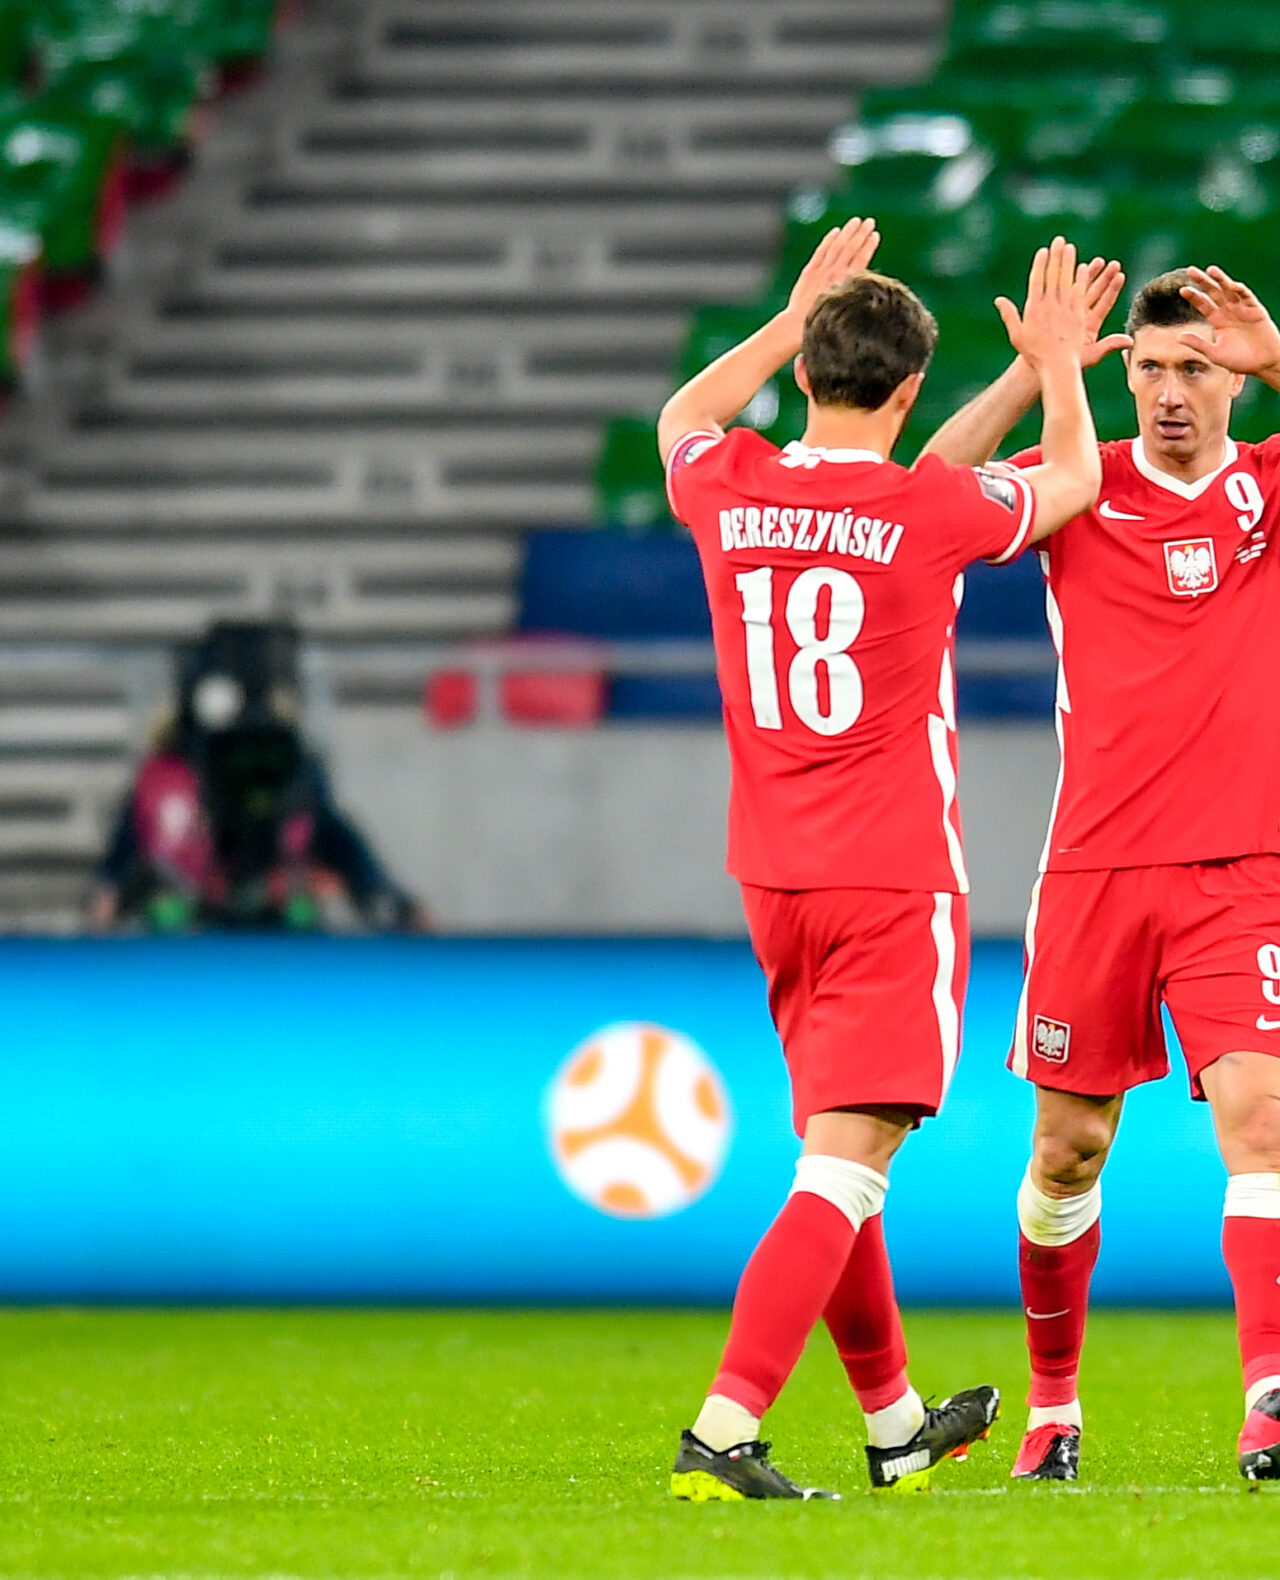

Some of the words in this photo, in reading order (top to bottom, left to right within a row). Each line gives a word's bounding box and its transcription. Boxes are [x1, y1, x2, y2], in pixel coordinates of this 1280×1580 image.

[1224, 472, 1264, 531] 9
[718, 507, 904, 565] BERESZYŃSKI
[735, 566, 865, 736] 18
